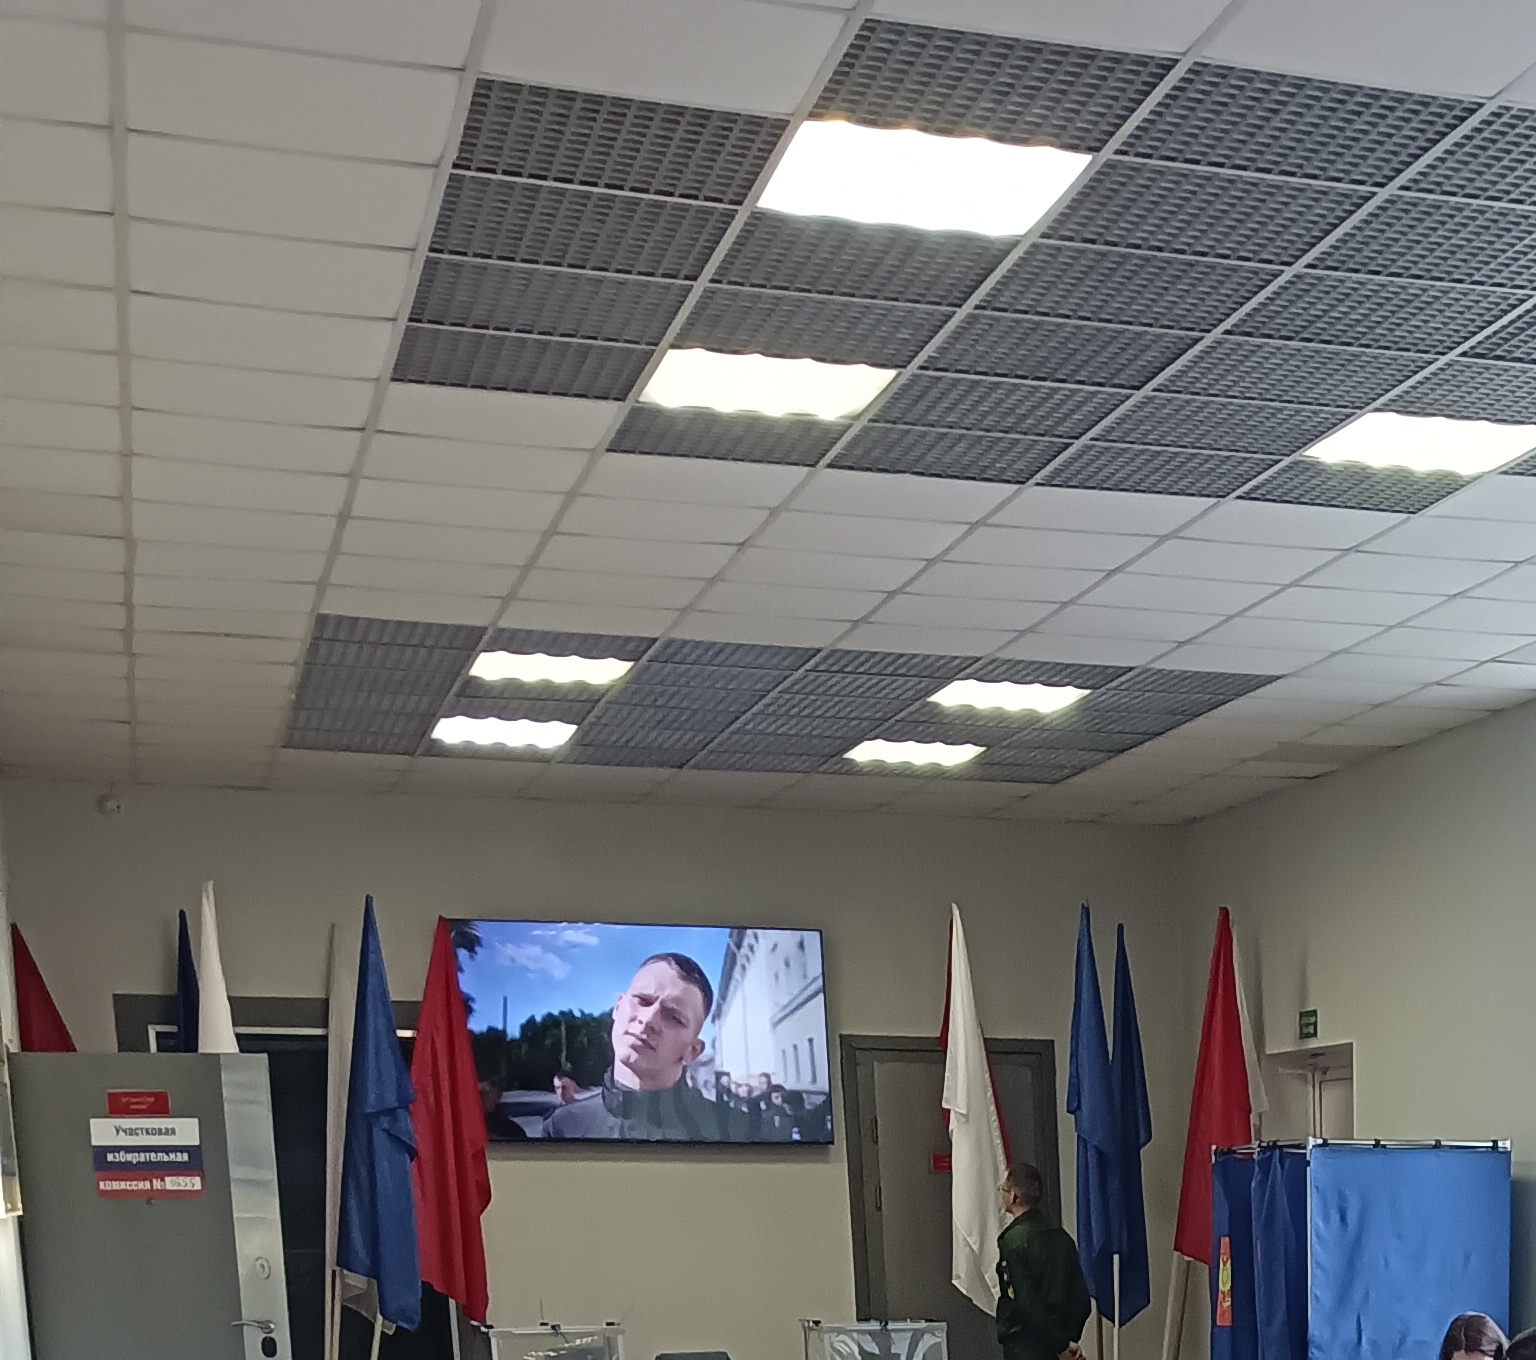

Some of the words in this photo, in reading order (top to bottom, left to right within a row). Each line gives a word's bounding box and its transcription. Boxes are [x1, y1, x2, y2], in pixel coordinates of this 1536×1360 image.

[113, 1124, 177, 1137] Участковая
[106, 1150, 189, 1165] избирательная
[99, 1180, 151, 1191] комиссия
